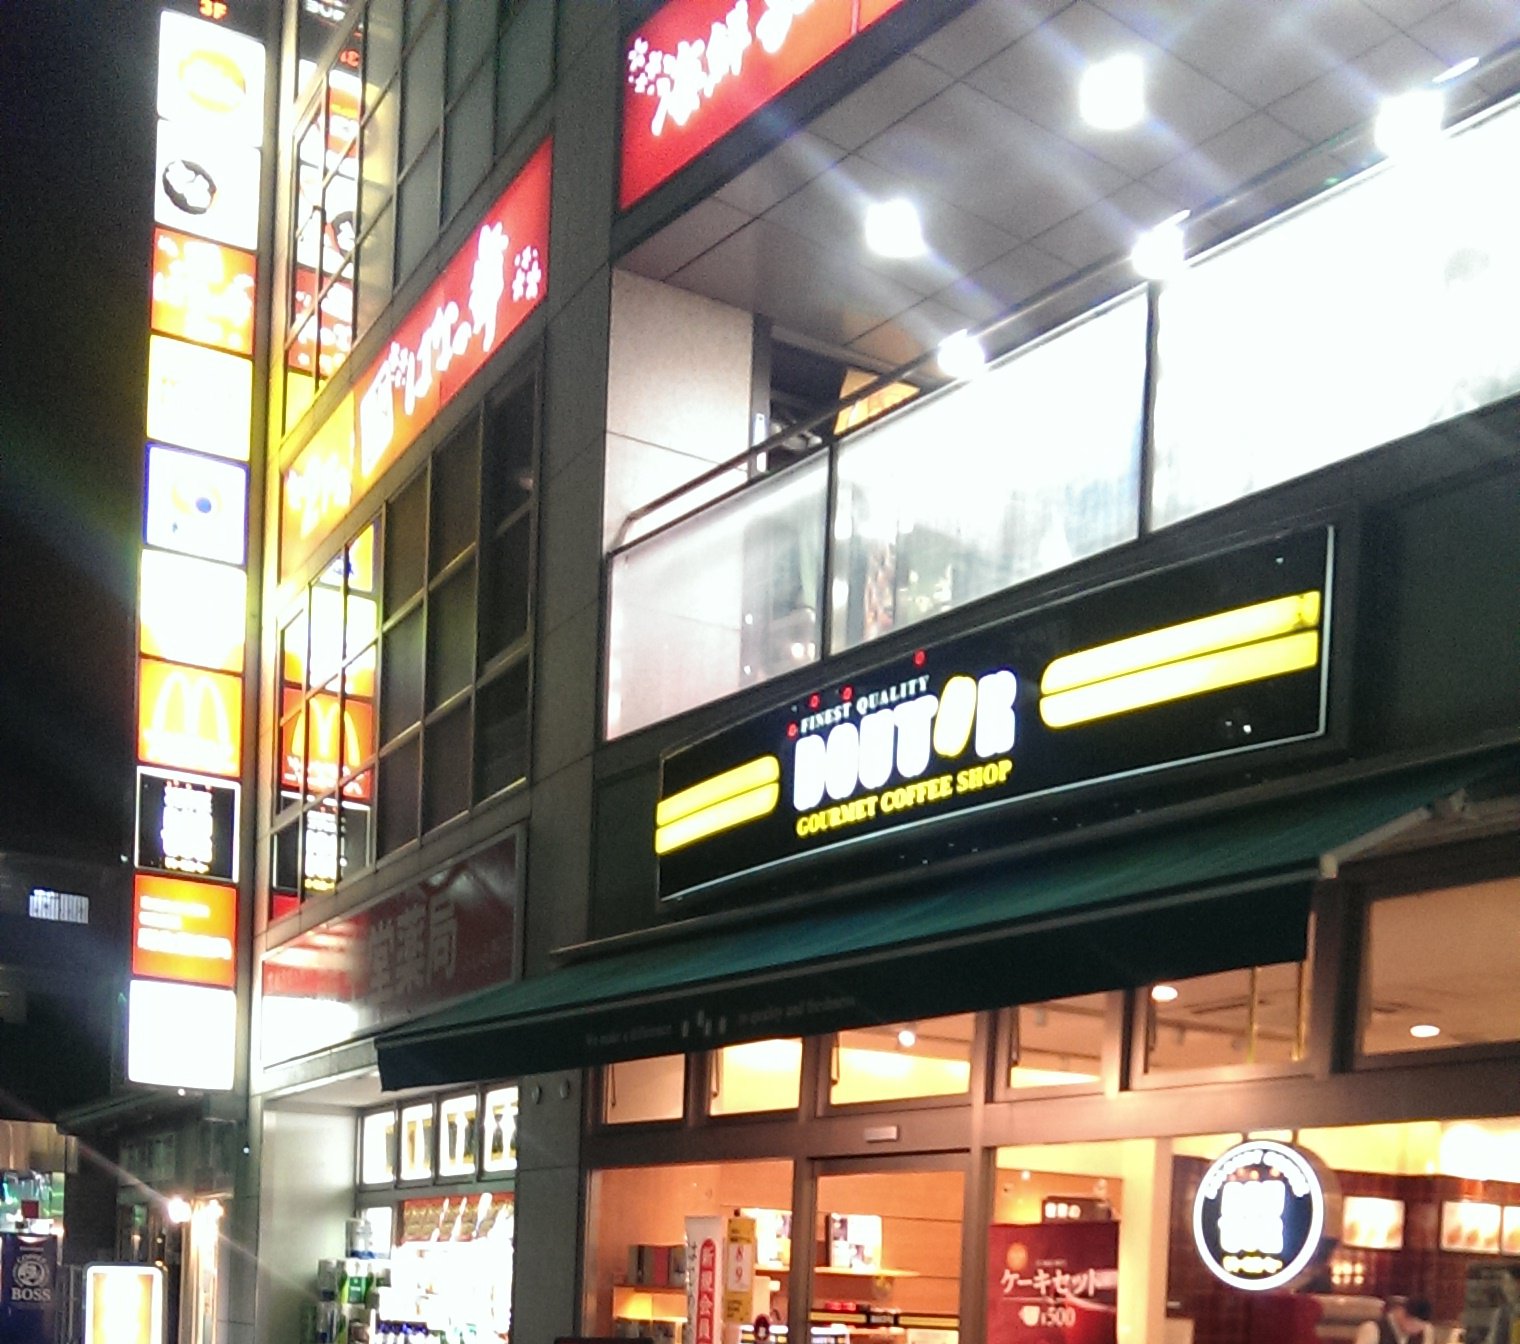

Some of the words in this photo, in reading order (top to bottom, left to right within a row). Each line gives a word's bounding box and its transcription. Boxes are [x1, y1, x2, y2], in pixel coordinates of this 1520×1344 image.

[800, 702, 852, 733] FINEST
[856, 675, 930, 715] QUALITY
[796, 795, 878, 837] GOURMET
[880, 774, 953, 813] COFFEE
[956, 759, 1013, 793] SHOP
[11, 1287, 52, 1301] BOSS
[1000, 1268, 1097, 1297] ケーキセット
